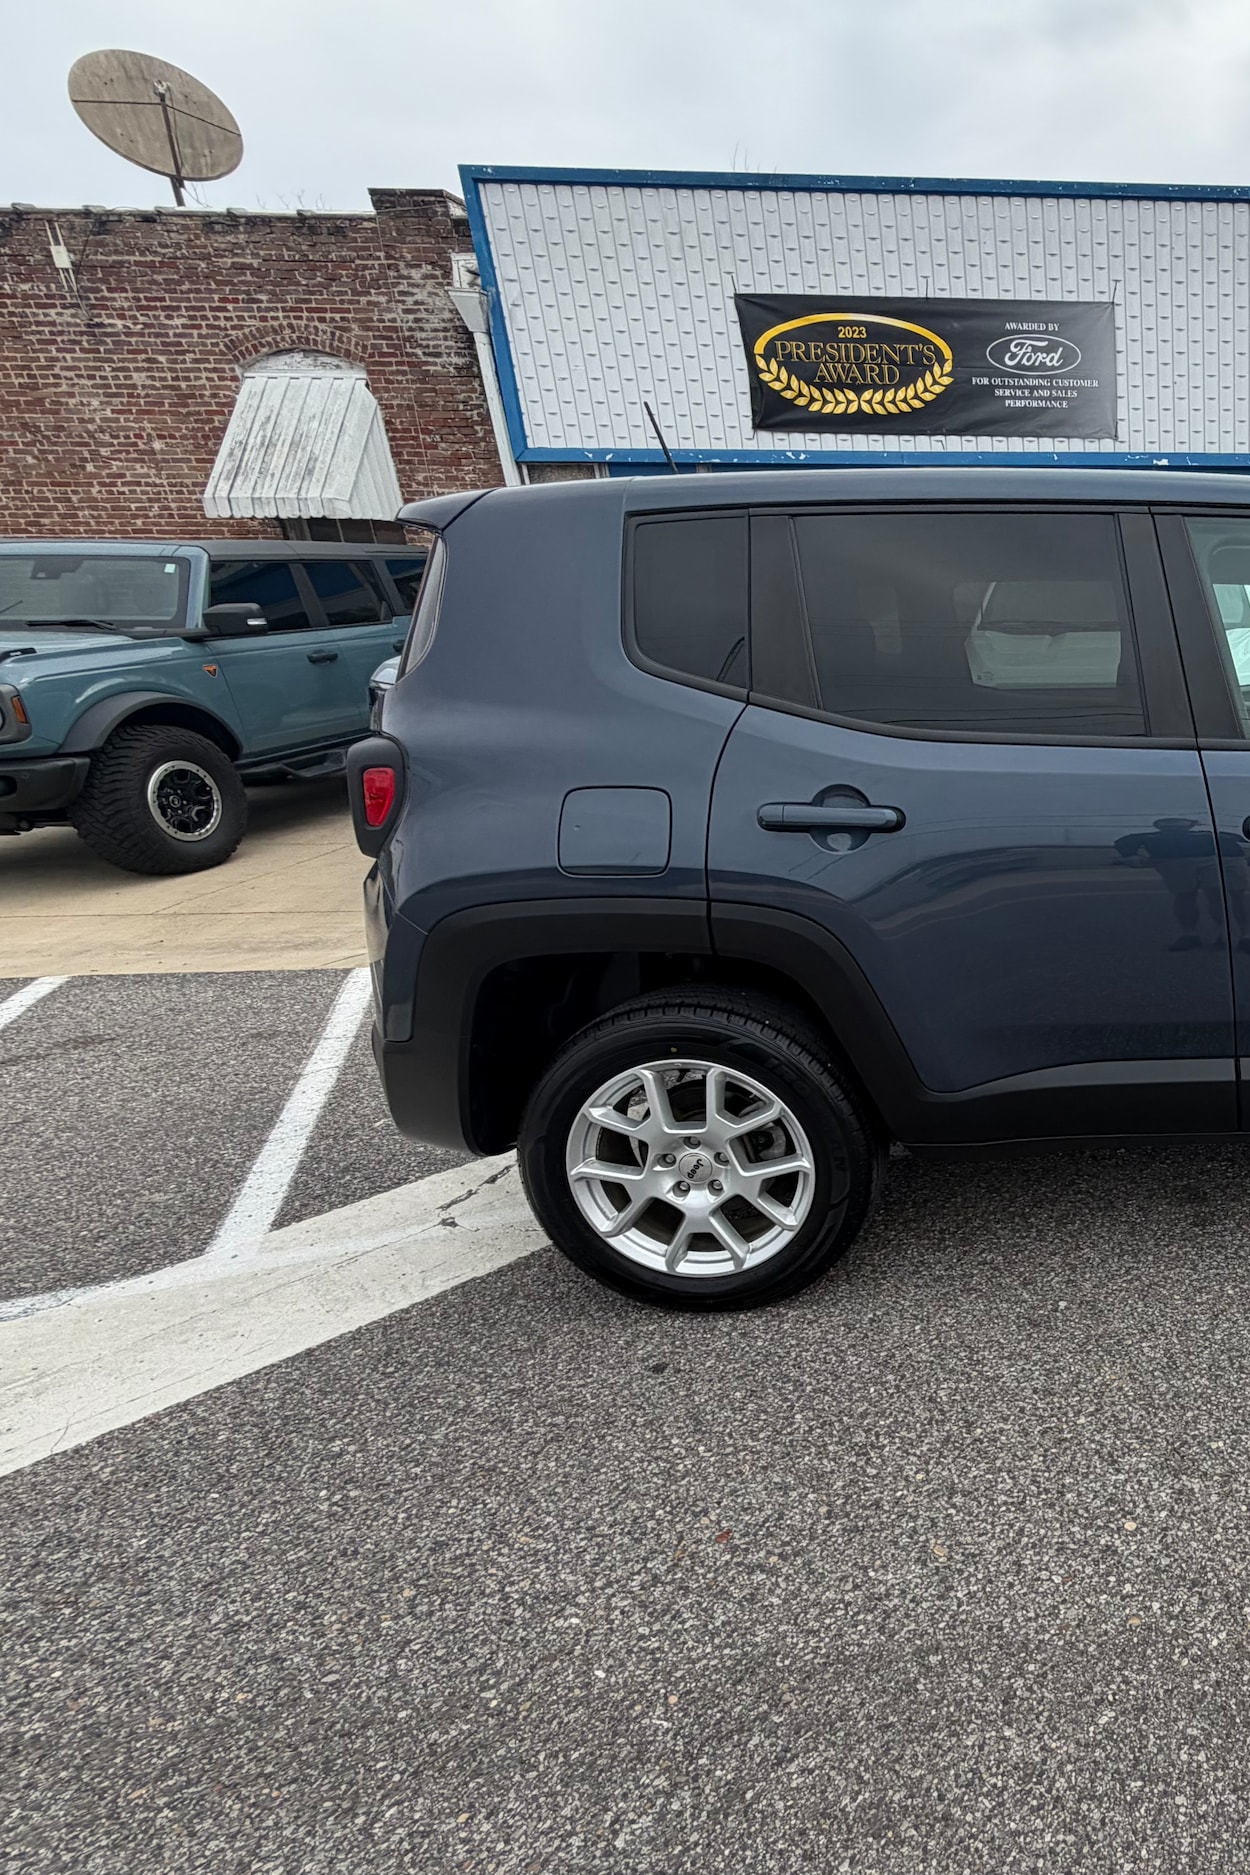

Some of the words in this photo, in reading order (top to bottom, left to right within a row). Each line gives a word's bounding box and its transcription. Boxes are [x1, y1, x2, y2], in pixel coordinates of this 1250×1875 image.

[838, 326, 867, 339] 2023
[1004, 322, 1046, 331] AWARDED
[1048, 323, 1060, 331] BY
[774, 340, 937, 366] PRESIDENT'S
[1004, 339, 1064, 367] Ford
[813, 362, 900, 386] AWARD
[971, 376, 990, 386] FOR
[991, 377, 1051, 387] OUTSTANDING
[1053, 379, 1099, 388] CUSTOMER
[994, 388, 1031, 397] SERVICE
[1033, 389, 1050, 398] AND
[1051, 389, 1078, 398] SALES
[1005, 399, 1069, 409] PERFORMANCE
[687, 1158, 704, 1179] Jeep
